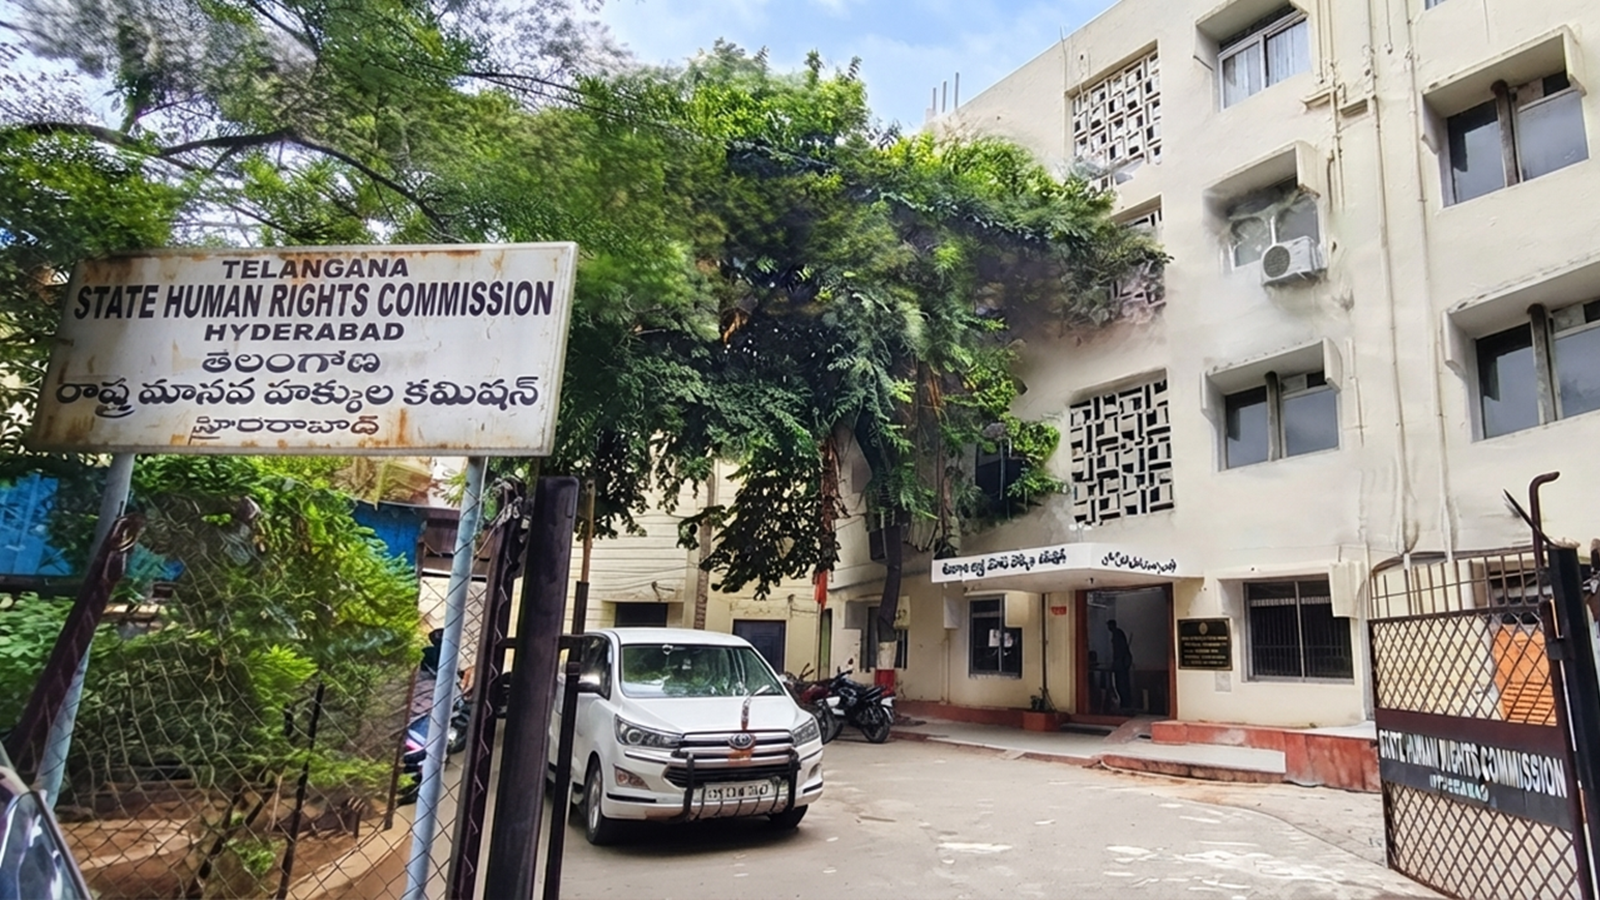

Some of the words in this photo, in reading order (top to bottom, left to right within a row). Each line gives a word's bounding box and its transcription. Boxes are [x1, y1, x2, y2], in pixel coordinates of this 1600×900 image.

[222, 258, 409, 279] TELANGANA
[74, 285, 159, 319] STATE
[163, 284, 263, 318] HUMAN
[268, 283, 370, 317] RIGHTS
[377, 281, 554, 317] COMMISSION
[204, 323, 404, 341] HYDERABAD
[1480, 746, 1567, 799] COMMISSION
